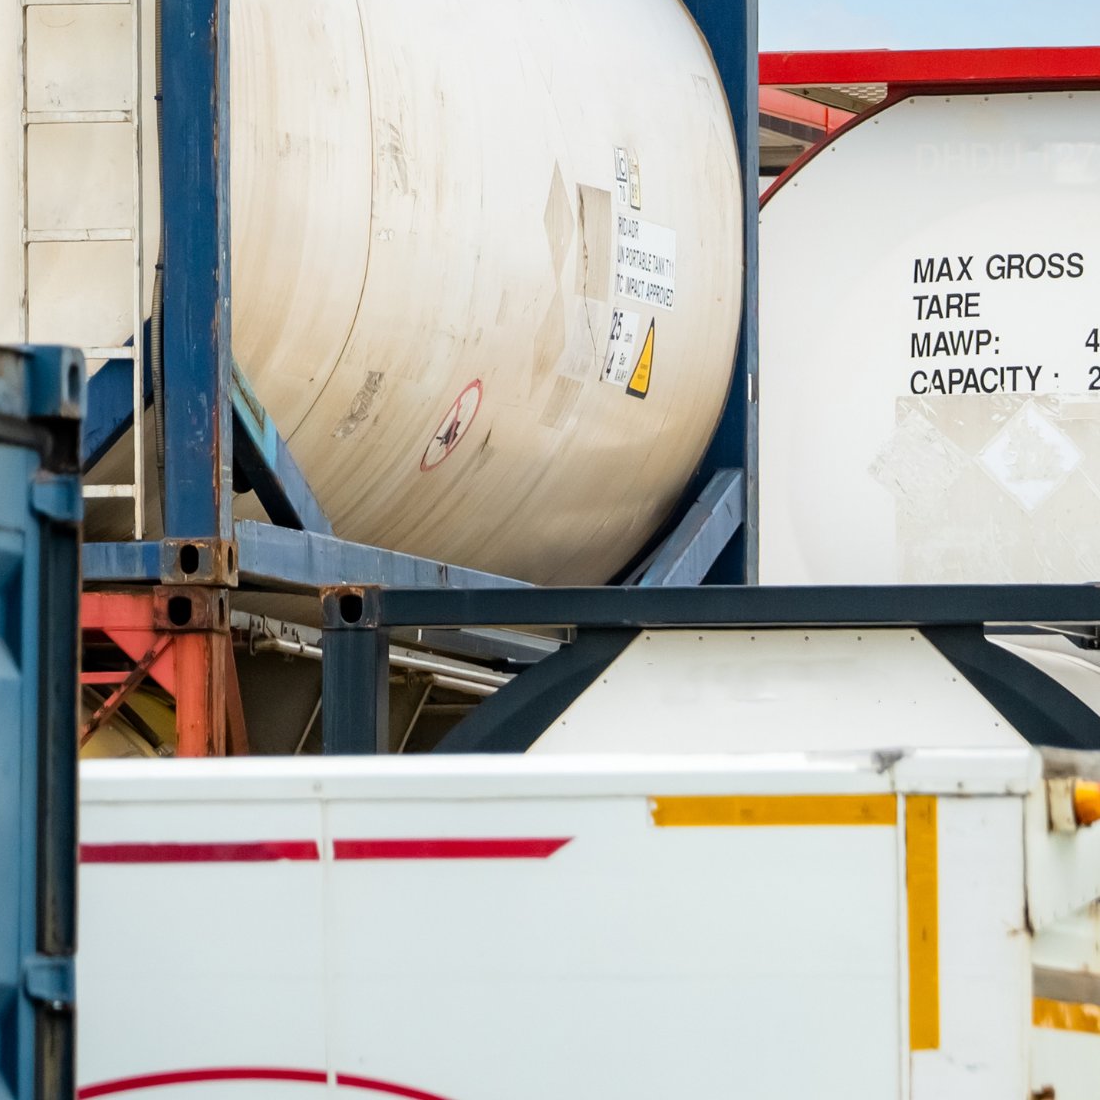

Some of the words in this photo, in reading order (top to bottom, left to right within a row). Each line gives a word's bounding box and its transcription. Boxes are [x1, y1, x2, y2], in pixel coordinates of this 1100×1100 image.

[617, 244, 624, 264] UN
[626, 247, 651, 272] PORTABLE
[653, 255, 665, 277] TANK
[913, 256, 974, 284] MAX
[985, 252, 1084, 280] GROSS
[615, 273, 623, 292] TC
[625, 276, 644, 299] IMPACT
[646, 282, 673, 307] APPROVED
[912, 292, 981, 320] TARE
[610, 311, 623, 340] 25
[910, 329, 1000, 358] MAWP:
[1085, 328, 1100, 353] 4
[910, 365, 1042, 395] CAPACITY
[1088, 365, 1100, 390] 2
